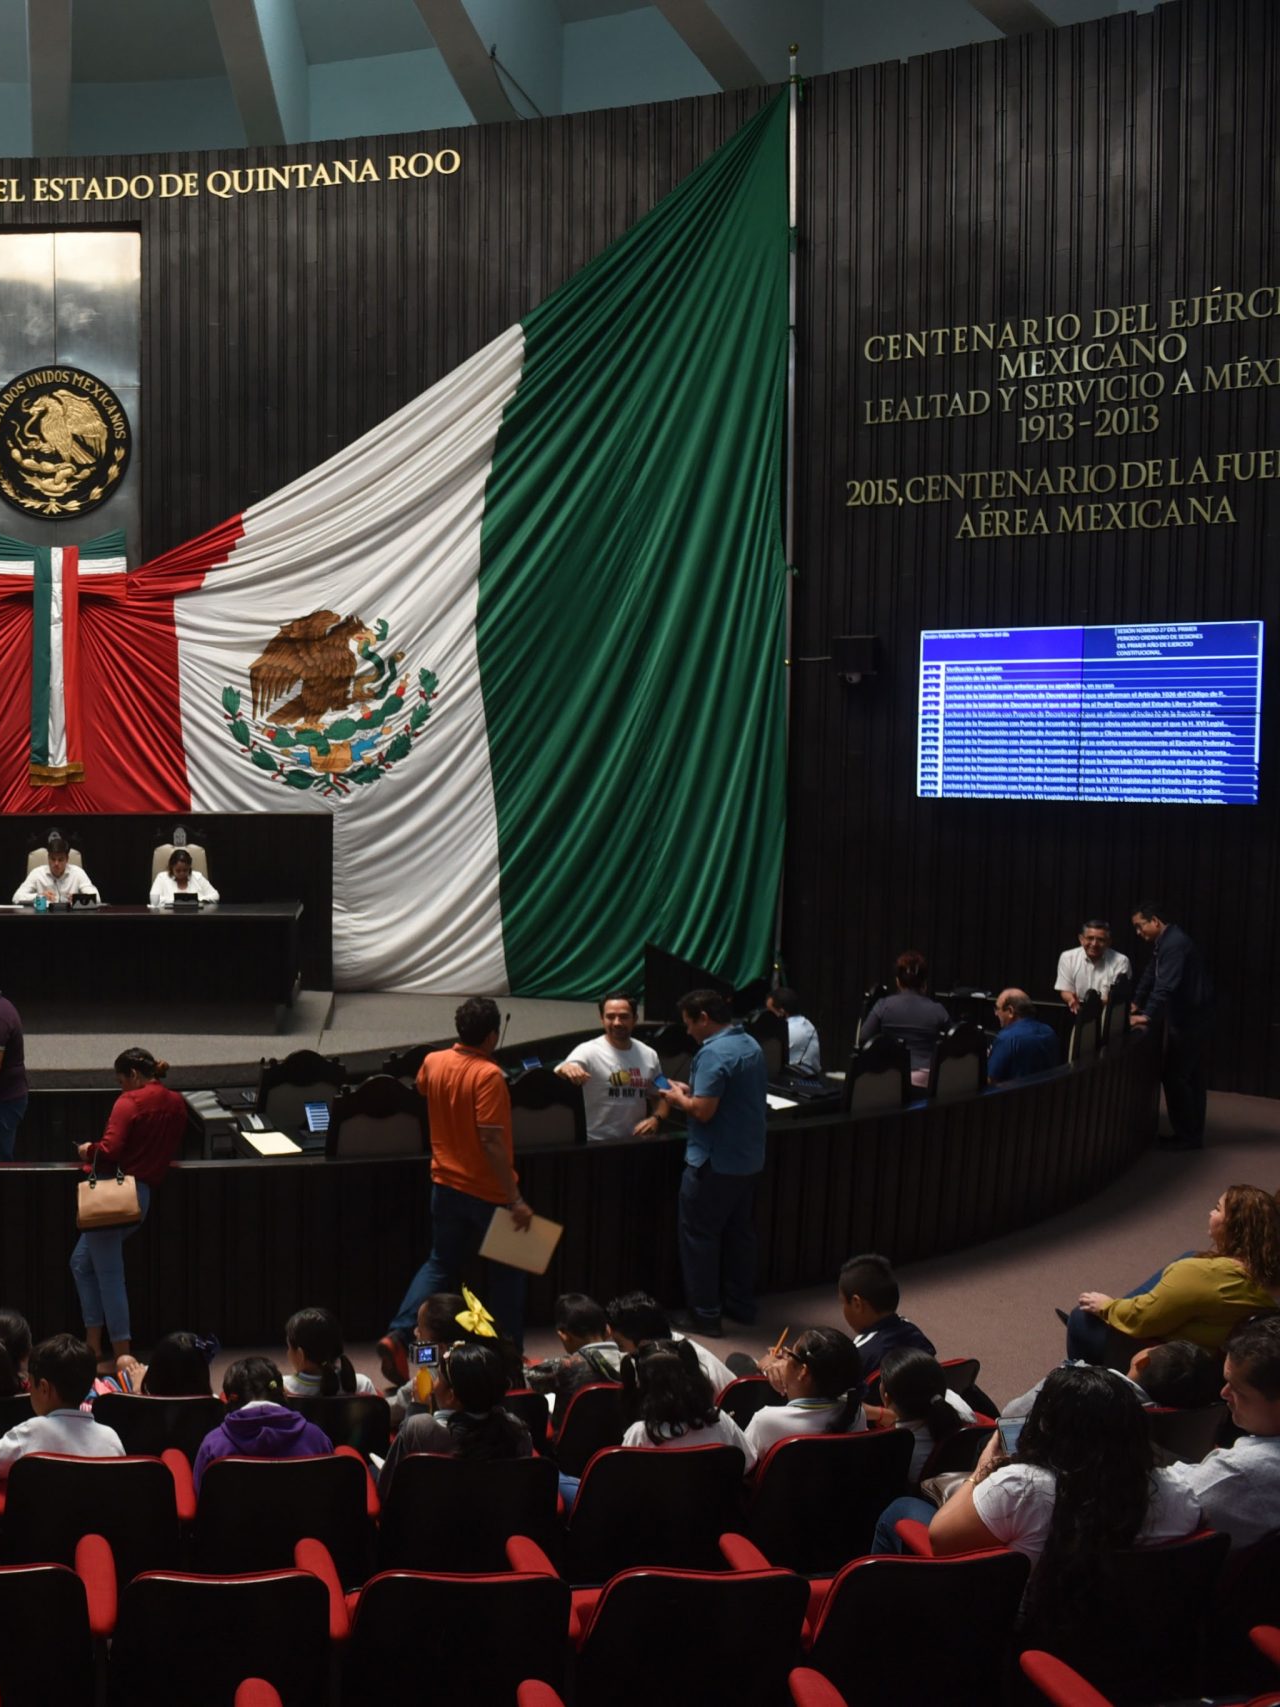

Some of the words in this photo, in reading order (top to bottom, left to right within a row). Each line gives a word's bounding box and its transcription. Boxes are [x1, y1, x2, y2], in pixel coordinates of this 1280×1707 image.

[32, 174, 154, 202] ESTADO
[159, 172, 199, 198] DE
[206, 157, 380, 199] QUINTANA
[388, 148, 461, 181] ROO
[864, 313, 1081, 363] CENTENARIO
[1092, 303, 1157, 338] DEL
[997, 333, 1187, 381] MEXICANO
[26, 370, 70, 388] UNIDOS
[72, 372, 126, 440] MEXICANOS
[863, 389, 990, 425] LEALTAD
[997, 386, 1017, 412] Y
[1023, 371, 1165, 411] SERVICIO
[1172, 368, 1195, 395] A
[1120, 459, 1163, 489] DE
[1168, 456, 1210, 486] LA
[954, 503, 1051, 539] AÉREA
[1057, 495, 1238, 533] MEXICANA
